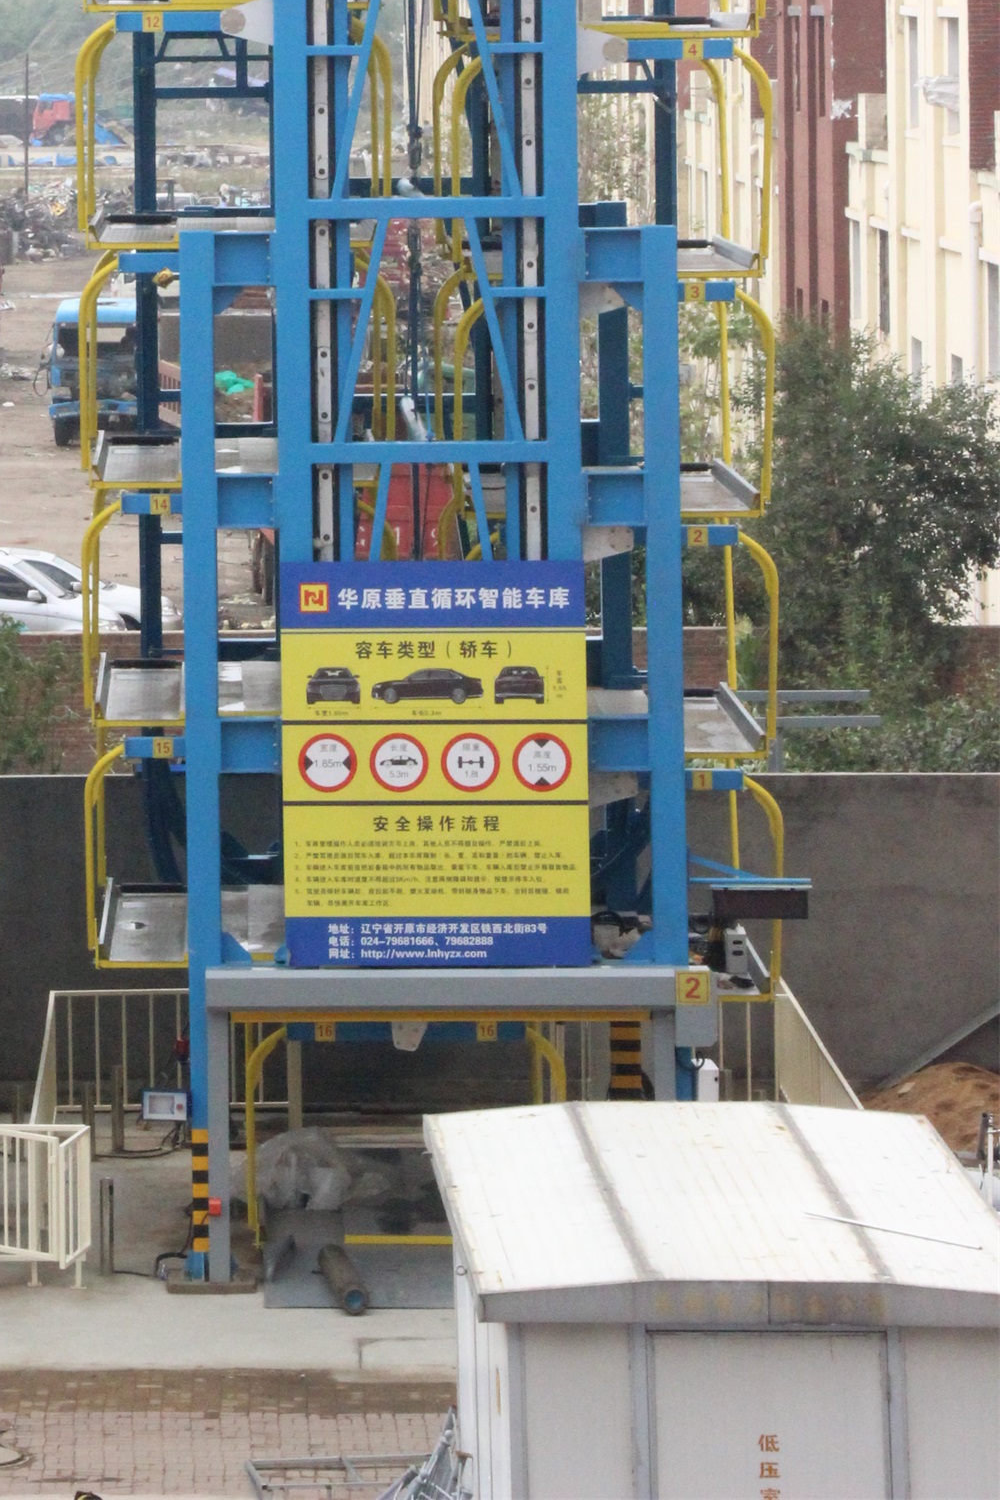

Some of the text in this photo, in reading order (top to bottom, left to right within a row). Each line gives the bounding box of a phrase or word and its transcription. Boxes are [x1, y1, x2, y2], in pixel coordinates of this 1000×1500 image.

[146, 15, 160, 29] 12
[688, 42, 698, 57] 4
[690, 285, 700, 299] 3
[154, 497, 168, 510] 14
[692, 529, 703, 543] 2
[337, 587, 570, 610] 华原垂直循环智能车库
[355, 640, 513, 659] 容车类型（轿车）
[156, 740, 170, 754] 15
[390, 743, 408, 752] 长度
[533, 750, 551, 760] 高度
[314, 759, 342, 768] 1.85m
[528, 763, 557, 773] 1.55m
[389, 770, 409, 778] 5.3m
[699, 772, 706, 787] 1
[373, 815, 500, 833] 安全操作流程
[685, 977, 701, 1000] 2
[318, 1024, 332, 1038] 16
[481, 1023, 495, 1037] 16
